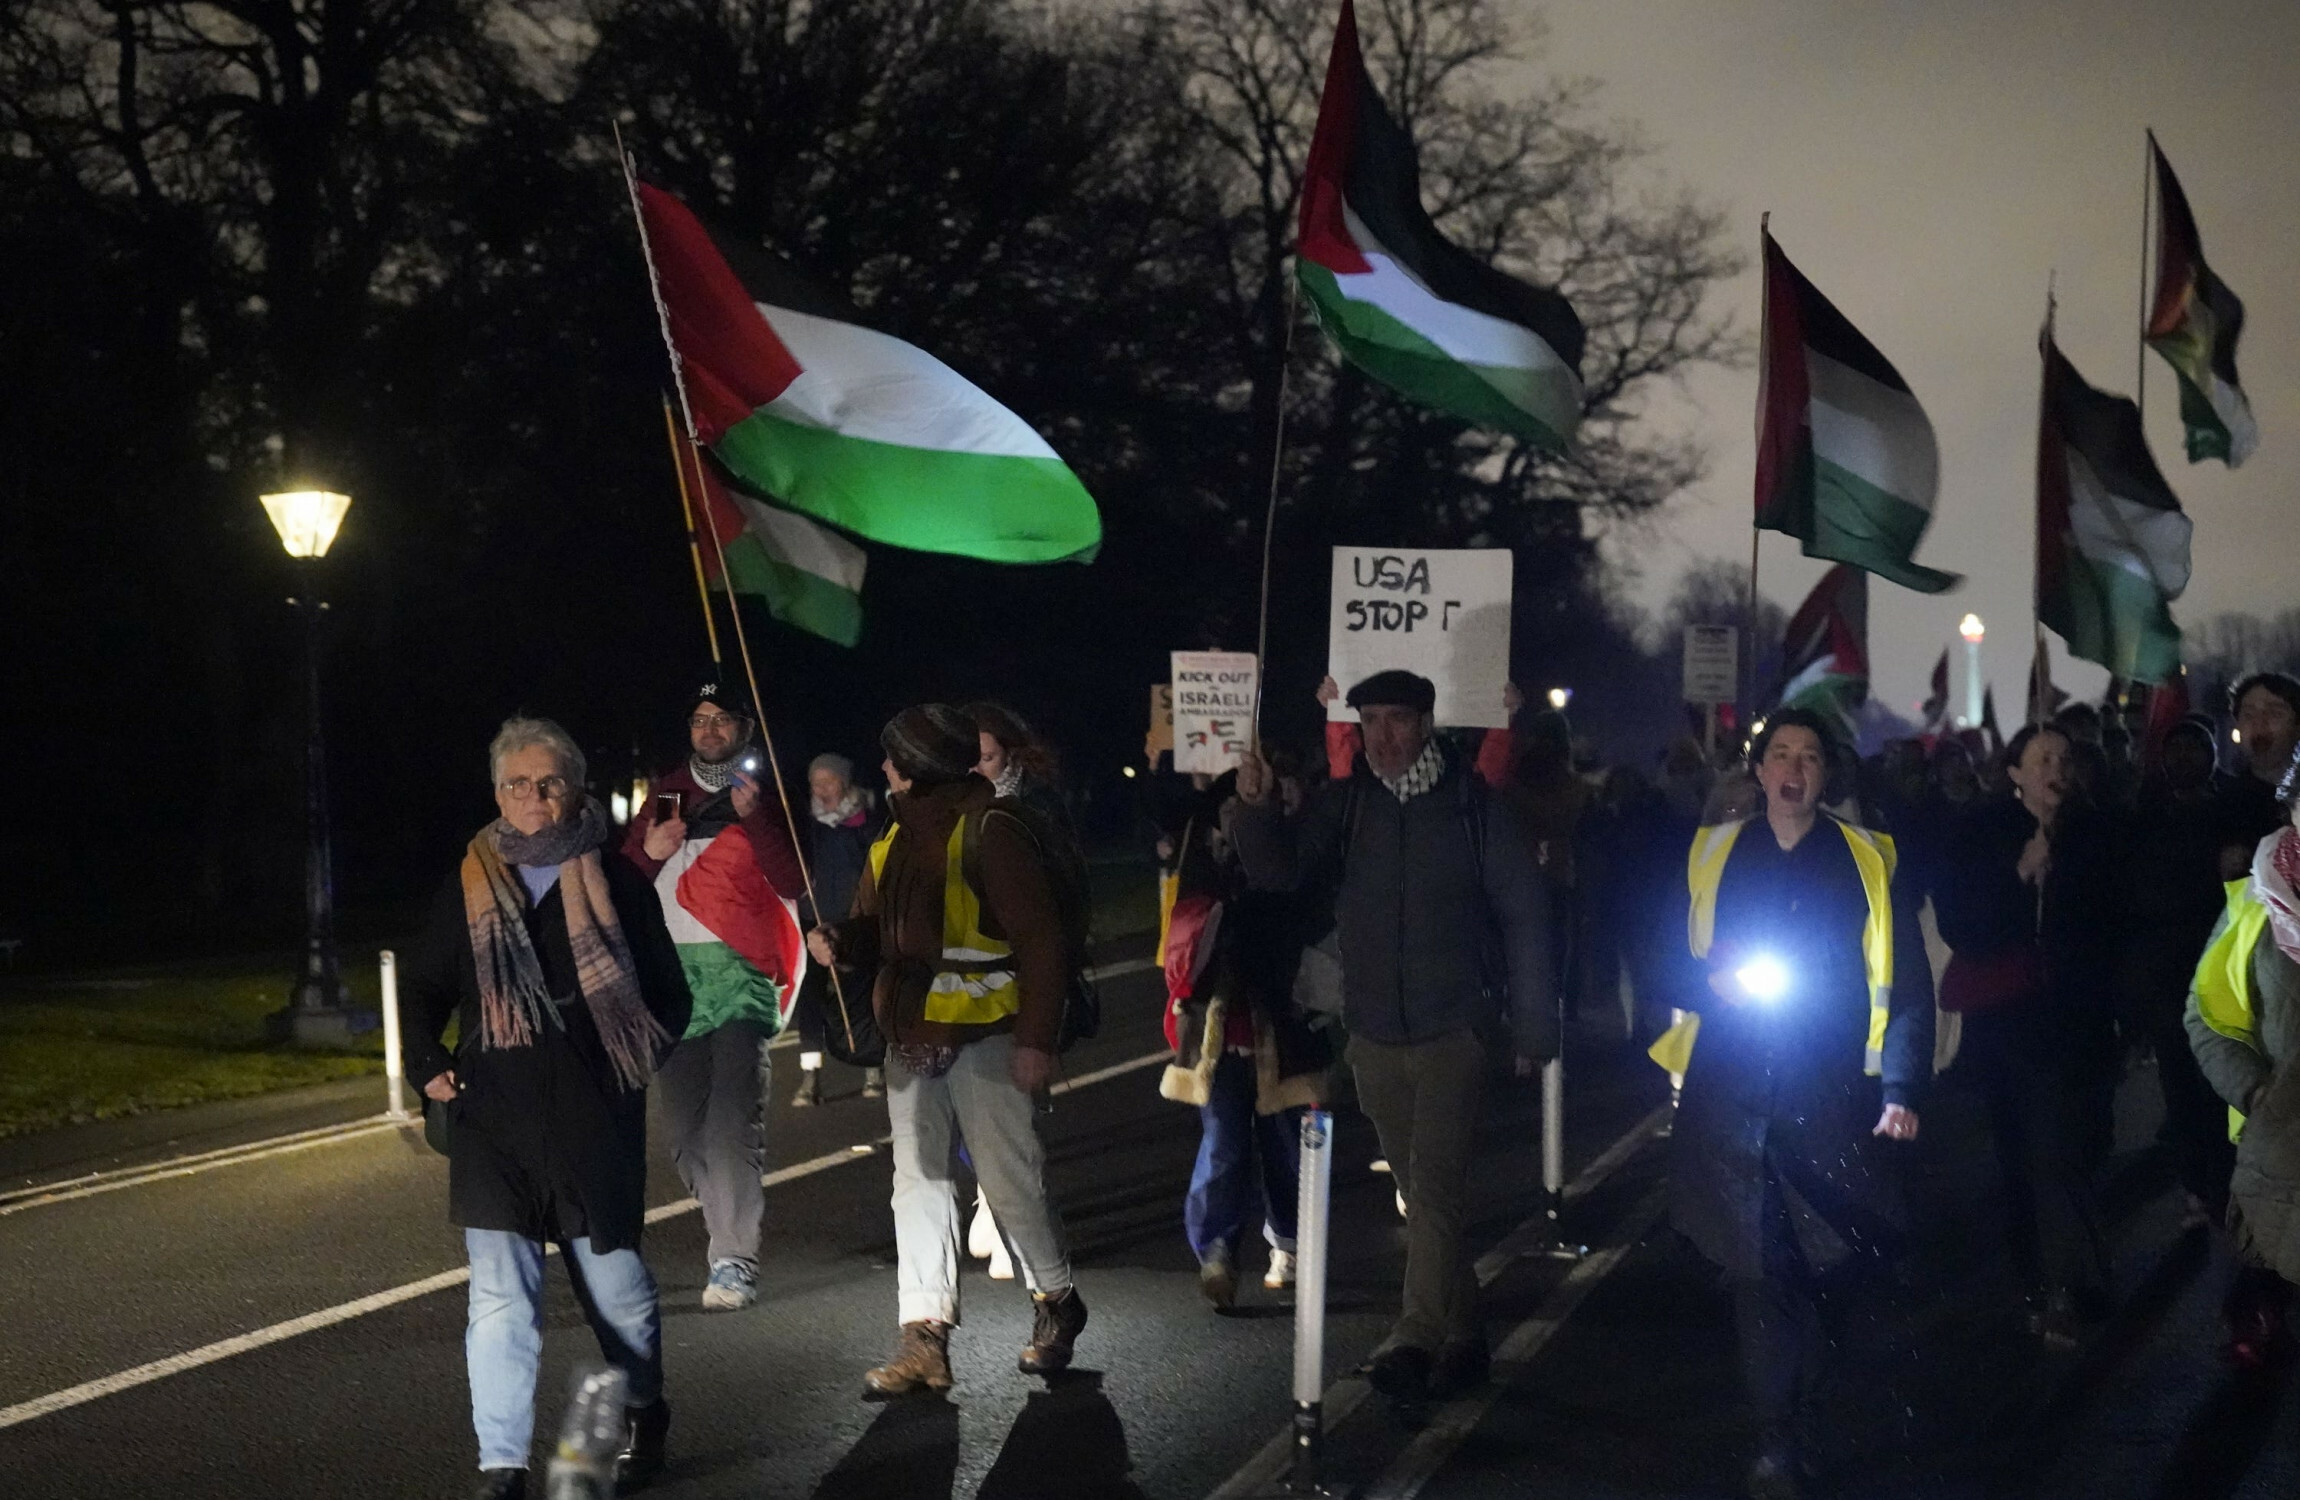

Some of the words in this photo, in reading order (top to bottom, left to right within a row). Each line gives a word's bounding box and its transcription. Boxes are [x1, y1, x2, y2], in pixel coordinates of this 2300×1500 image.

[1354, 555, 1430, 595] USA
[1346, 600, 1428, 632] STOP
[1178, 671, 1213, 683] KICK
[1218, 672, 1251, 684] OUT
[1180, 691, 1250, 706] ISRAELI
